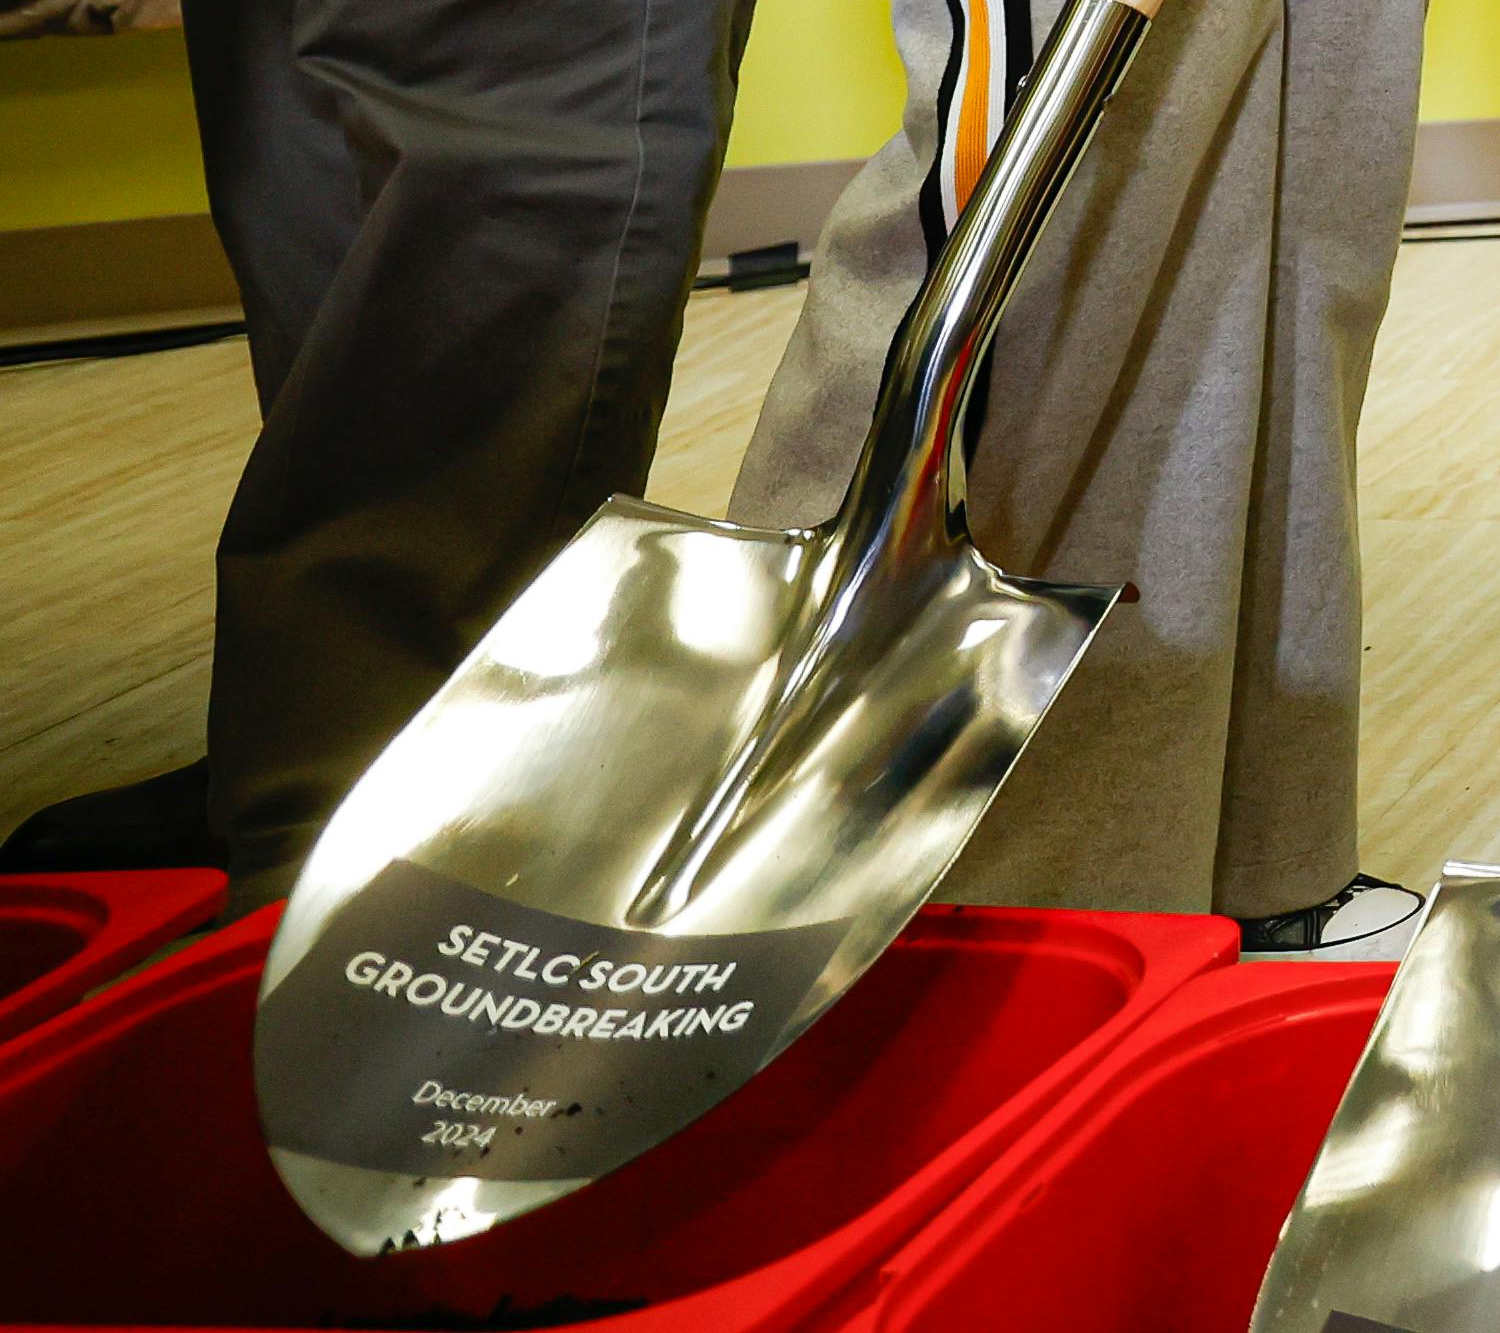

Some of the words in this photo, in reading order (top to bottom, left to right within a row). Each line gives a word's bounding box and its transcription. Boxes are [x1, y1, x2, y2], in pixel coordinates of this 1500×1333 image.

[436, 924, 582, 987] SETLC
[578, 958, 738, 996] SOUTH
[344, 951, 755, 1040] GROUNDBREAKING
[413, 1080, 558, 1120] December
[421, 1120, 498, 1148] 2024
